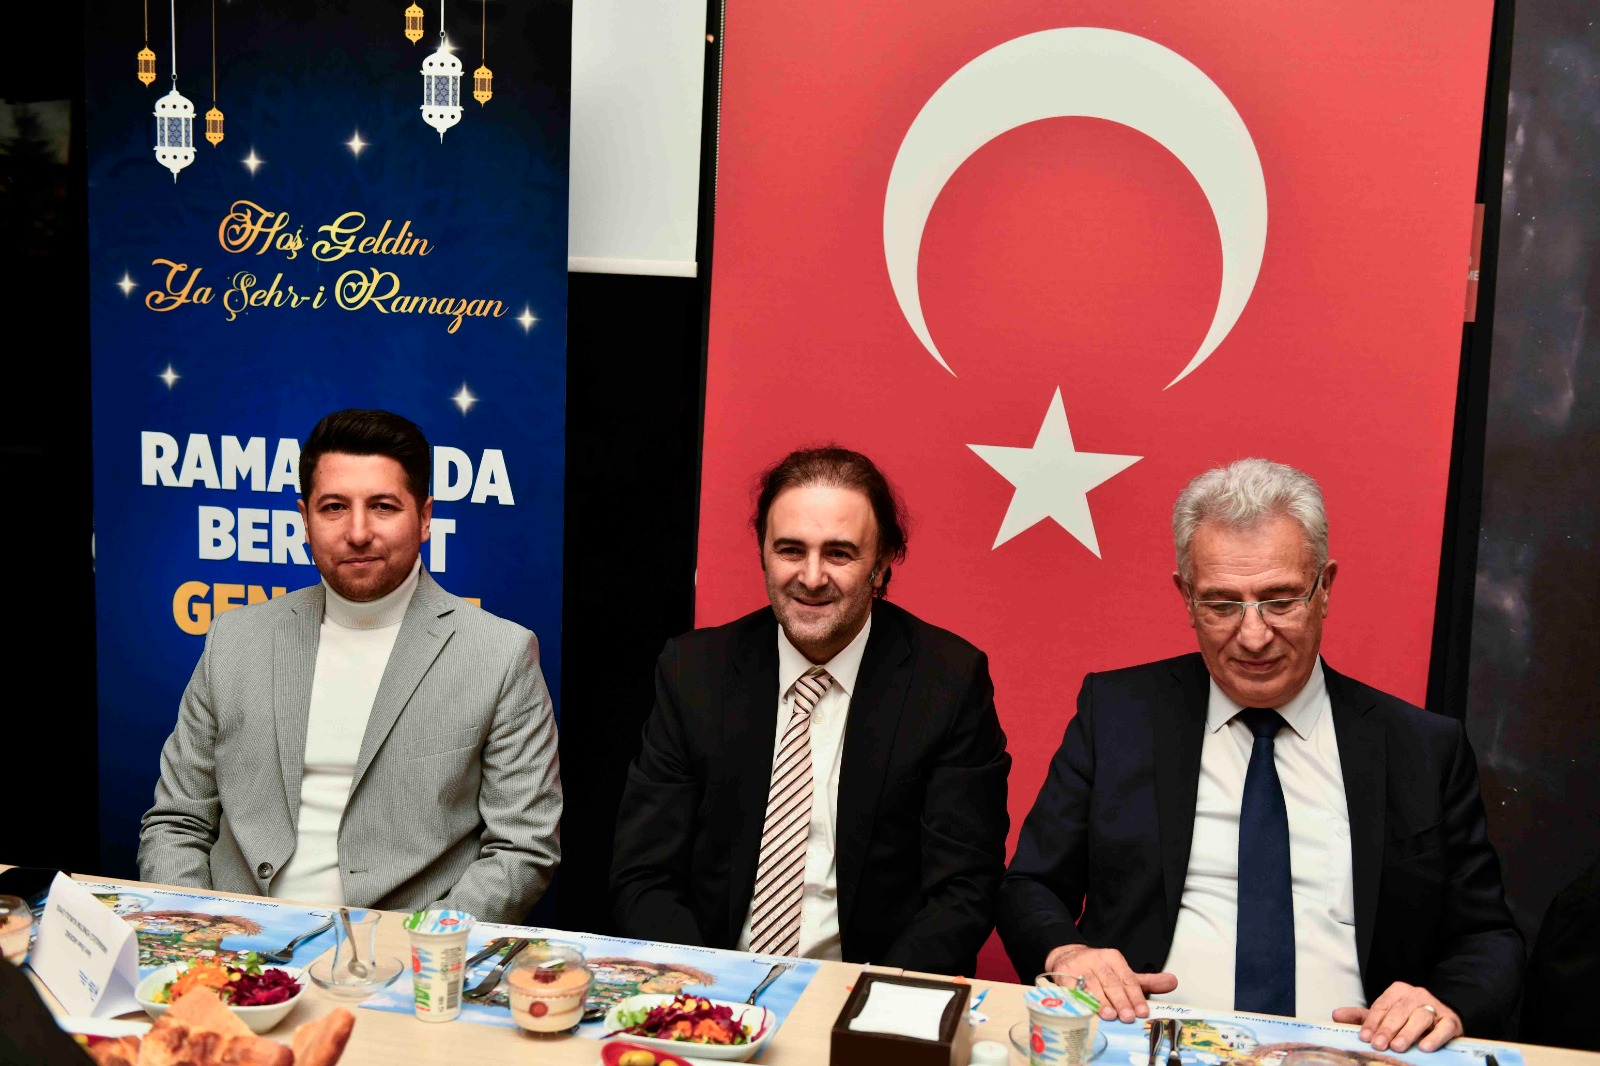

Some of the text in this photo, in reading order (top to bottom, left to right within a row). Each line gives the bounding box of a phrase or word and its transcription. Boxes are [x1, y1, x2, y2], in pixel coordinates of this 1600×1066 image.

[311, 211, 433, 262] Geldin
[145, 258, 509, 334] Ya Şehr-i Ramazan
[141, 431, 515, 506] RAMADA
[198, 505, 456, 573] BERT
[1233, 1014, 1289, 1026] Restaurant
[1290, 1021, 1313, 1029] Cafe
